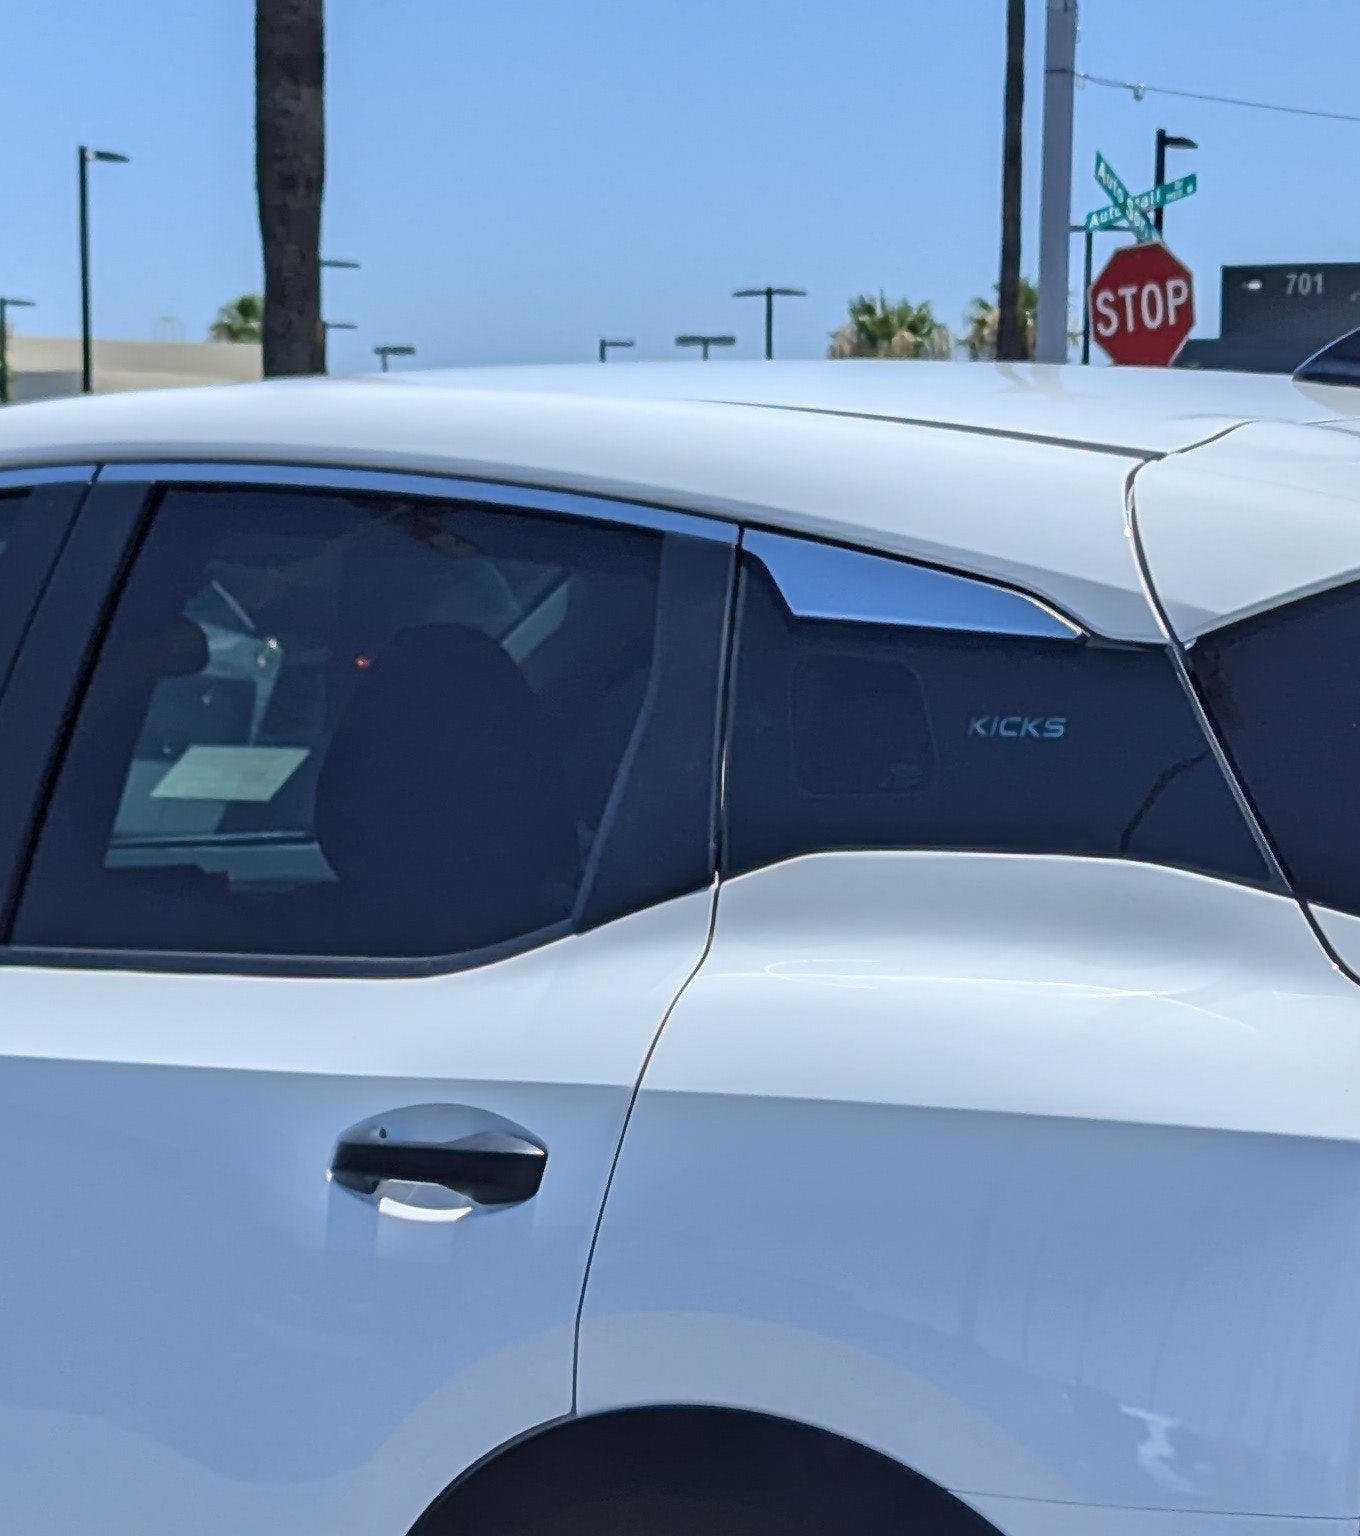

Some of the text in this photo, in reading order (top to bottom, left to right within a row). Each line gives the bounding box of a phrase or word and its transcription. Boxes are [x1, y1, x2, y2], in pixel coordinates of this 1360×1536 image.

[1286, 273, 1324, 296] 701
[1096, 278, 1189, 337] STOP
[968, 716, 1067, 738] KICKS
